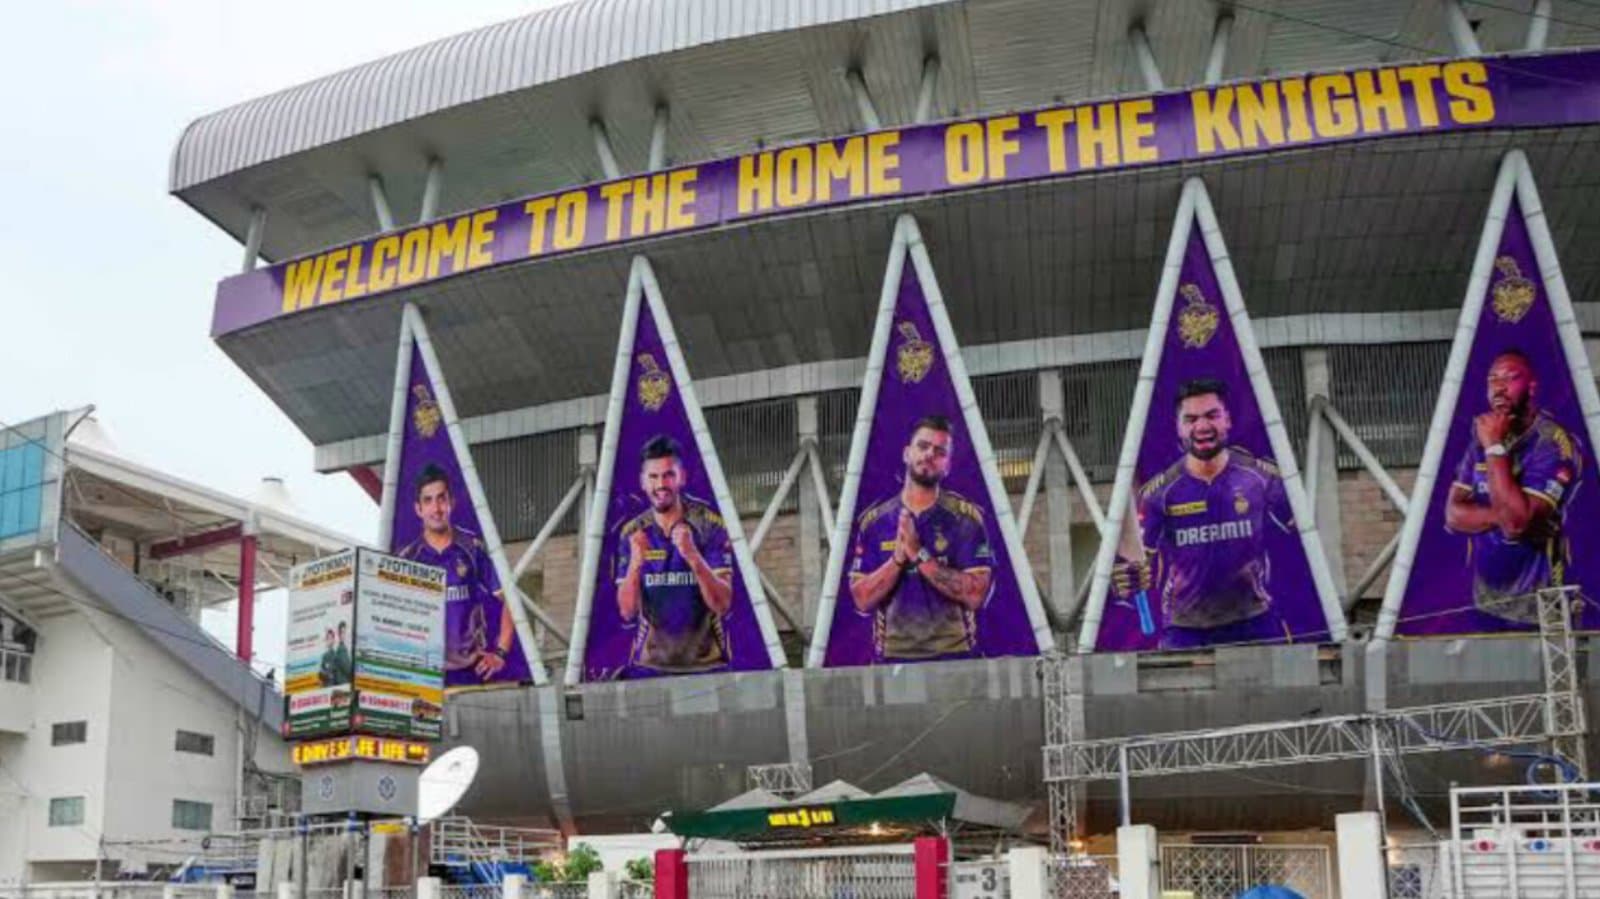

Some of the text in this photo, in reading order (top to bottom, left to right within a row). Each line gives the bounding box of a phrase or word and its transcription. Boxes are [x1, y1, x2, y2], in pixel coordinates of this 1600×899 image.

[281, 60, 1496, 314] WELCOME TO THE HOME OF THE KNIGHTS
[981, 867, 997, 891] 3
